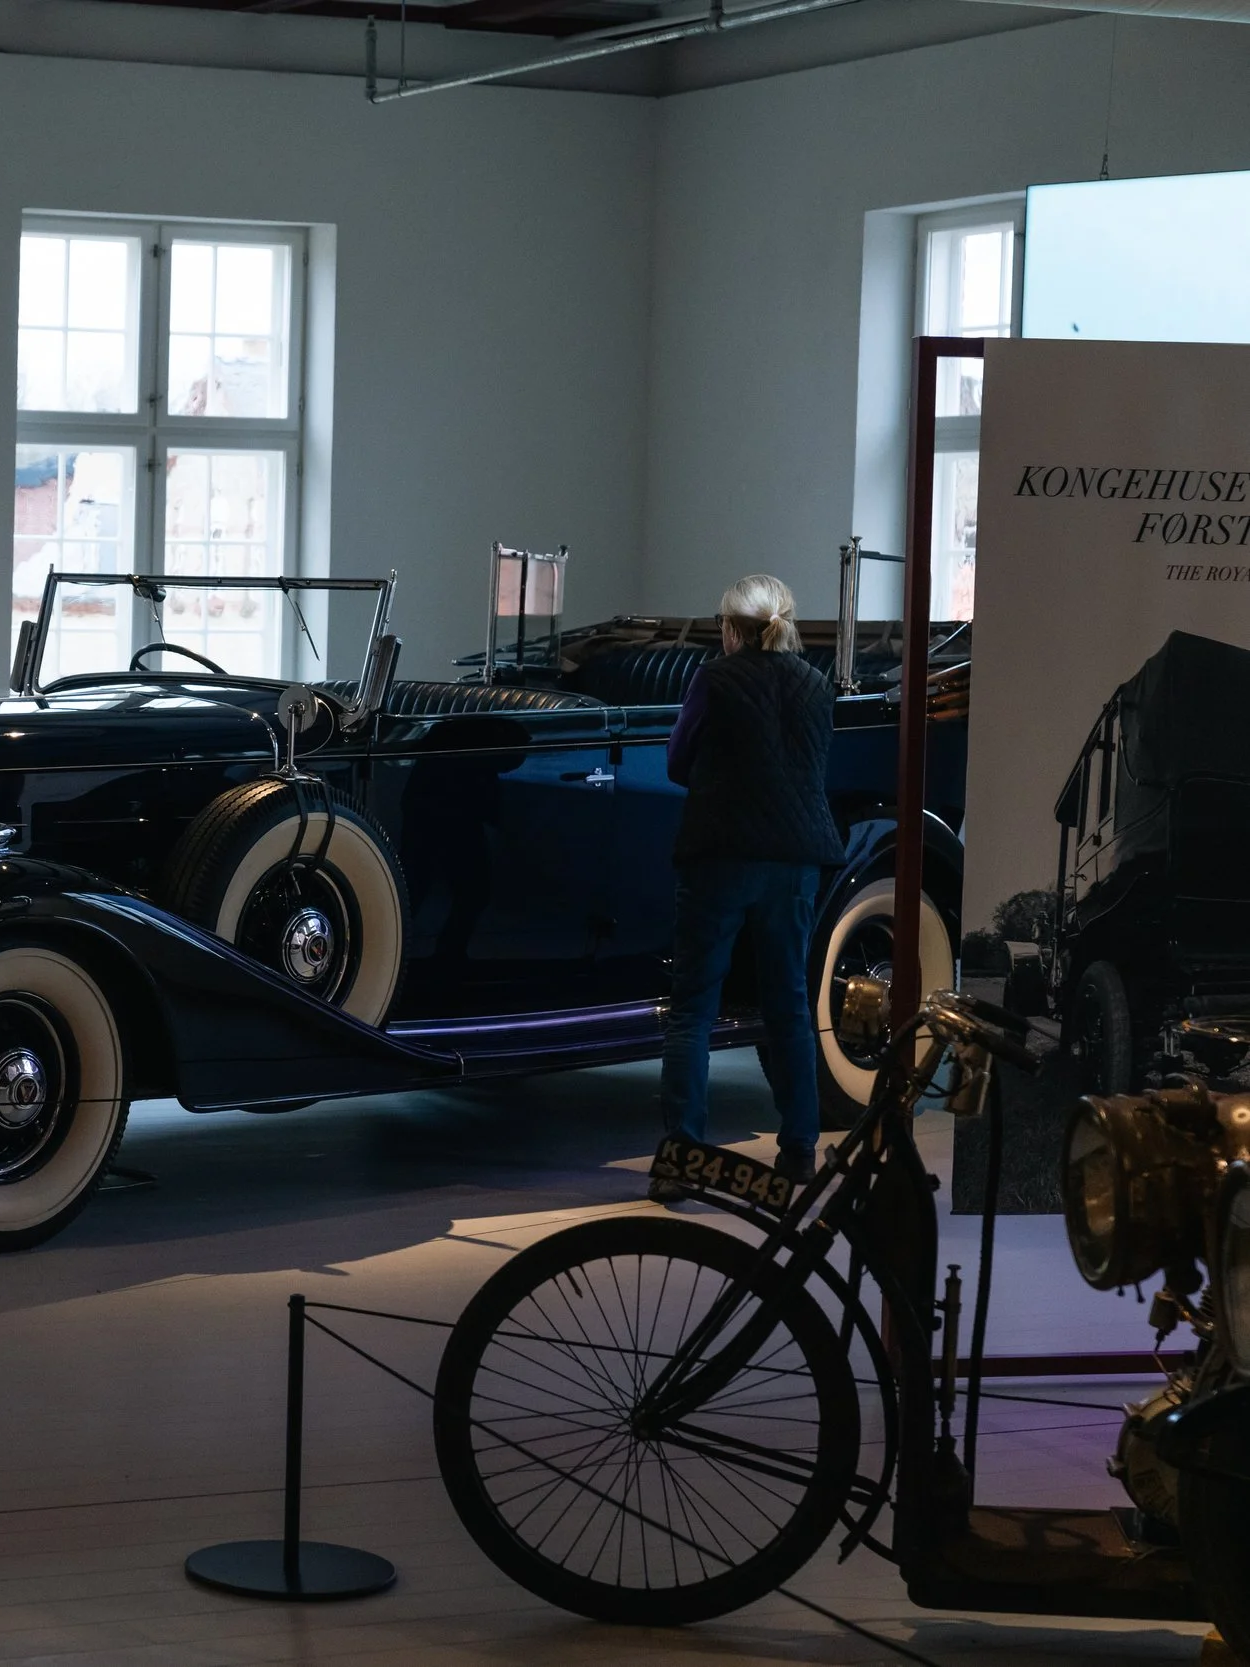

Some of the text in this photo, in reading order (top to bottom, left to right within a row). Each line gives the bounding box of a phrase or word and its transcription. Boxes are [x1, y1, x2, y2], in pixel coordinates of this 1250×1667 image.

[1013, 466, 1250, 502] KONGEHUSE
[1166, 564, 1203, 581] THE
[661, 1140, 681, 1162] K
